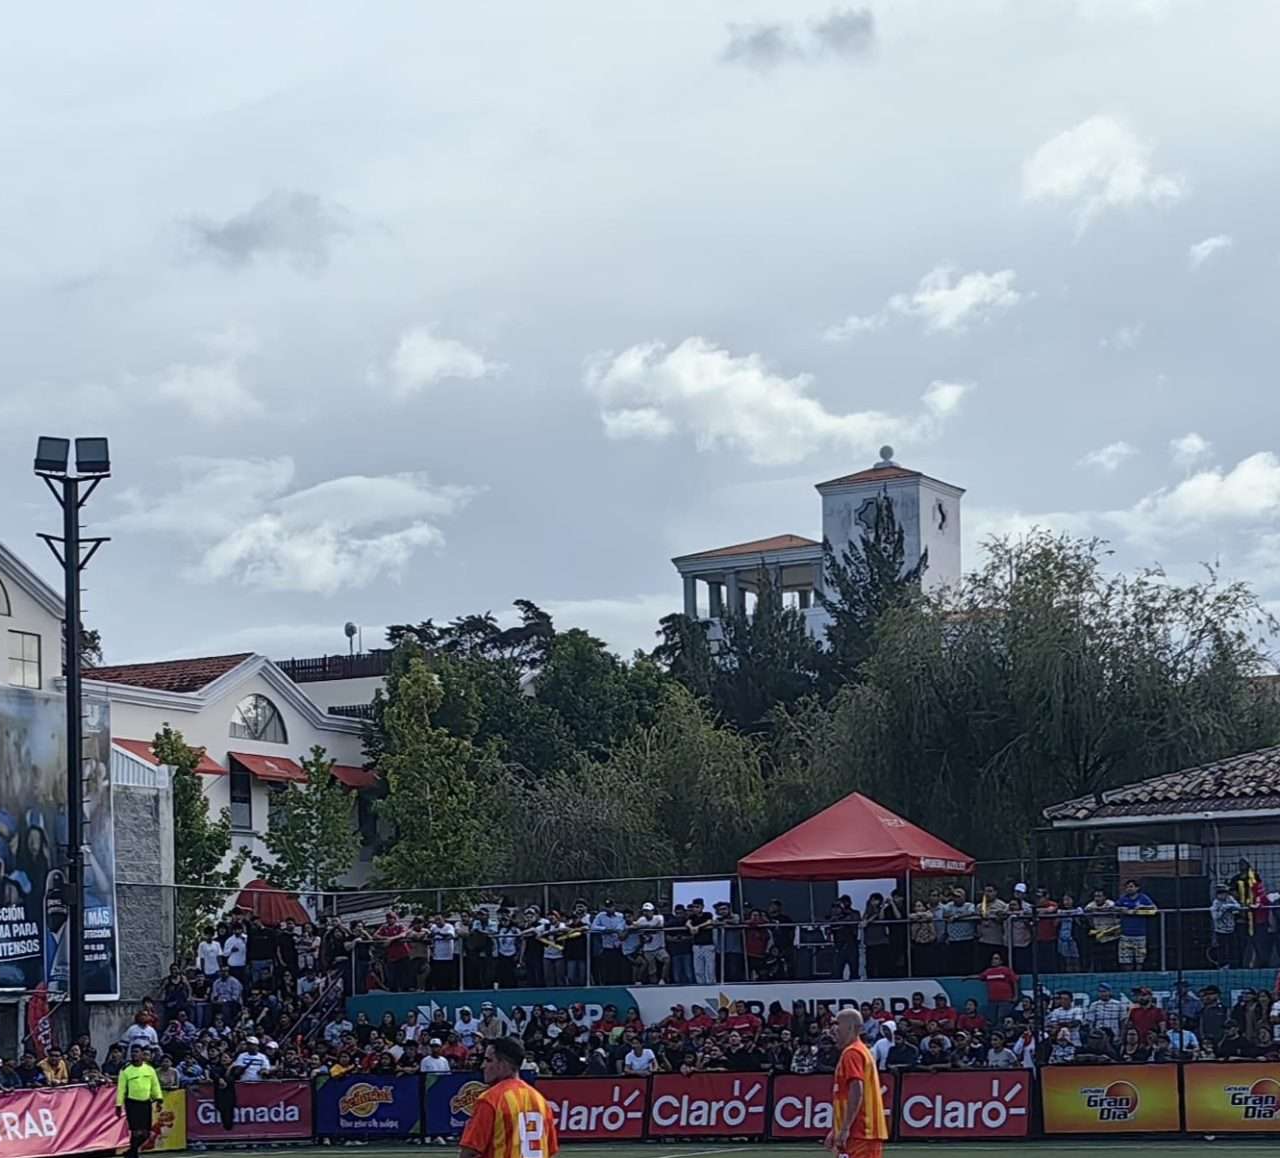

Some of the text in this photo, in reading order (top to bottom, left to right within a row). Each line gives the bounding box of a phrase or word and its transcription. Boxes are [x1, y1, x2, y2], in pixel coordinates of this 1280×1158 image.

[13, 922, 38, 937] PARA
[652, 1095, 746, 1127] Claro
[774, 1096, 833, 1128] Cla
[902, 1095, 1007, 1129] Claro
